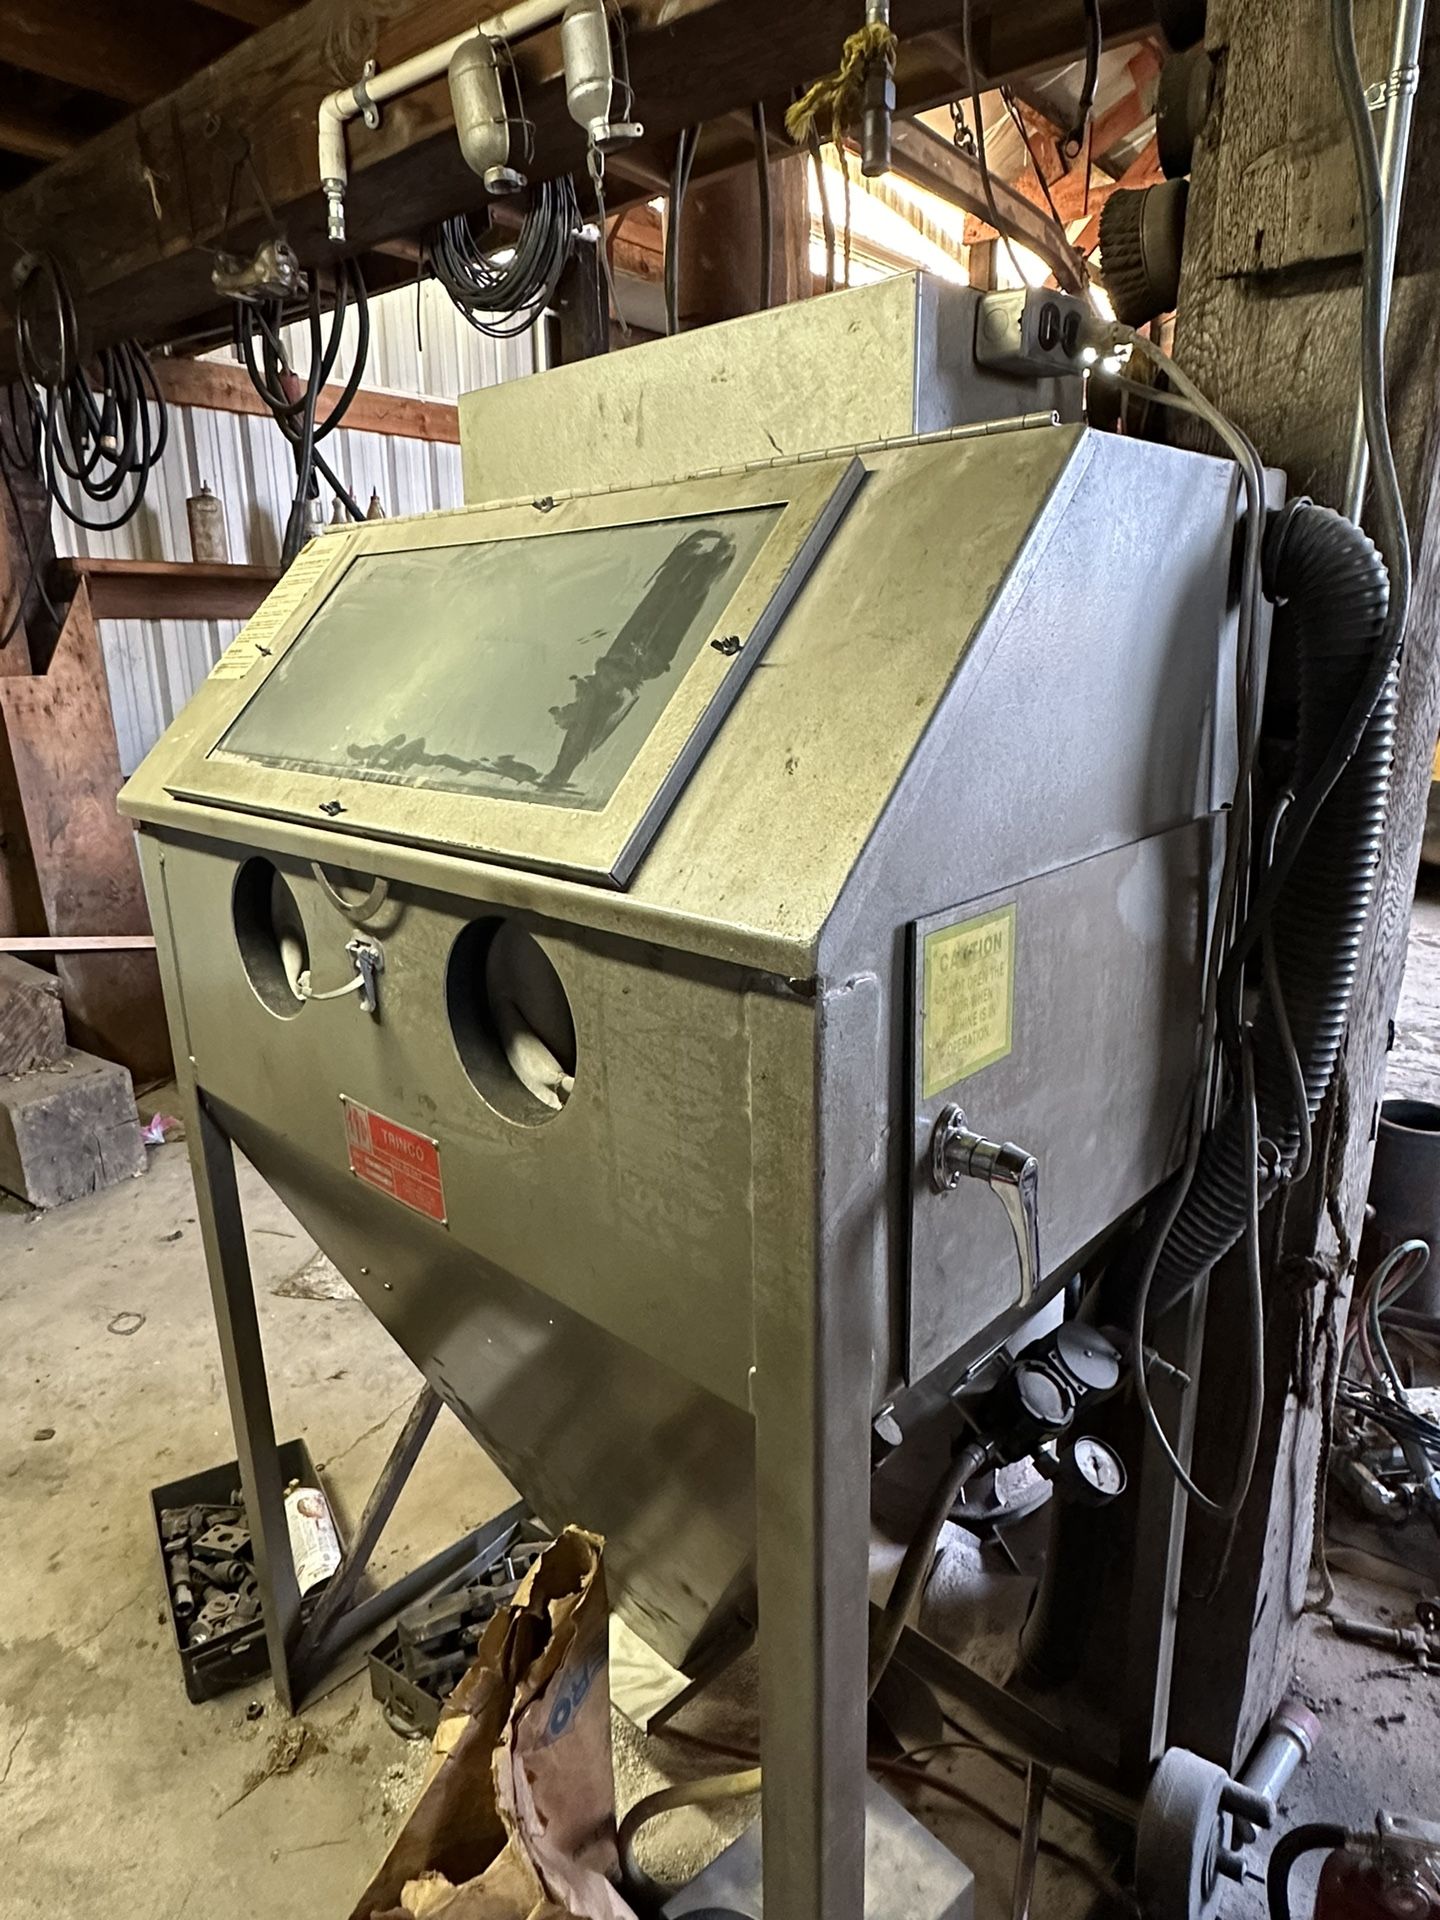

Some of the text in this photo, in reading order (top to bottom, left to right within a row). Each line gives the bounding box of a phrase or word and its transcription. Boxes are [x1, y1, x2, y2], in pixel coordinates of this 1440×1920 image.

[940, 931, 1002, 973] CAUTION
[967, 968, 989, 990] OPEN
[990, 960, 1004, 981] THE
[970, 987, 993, 1008] WHEN
[381, 1129, 425, 1162] TRINCO
